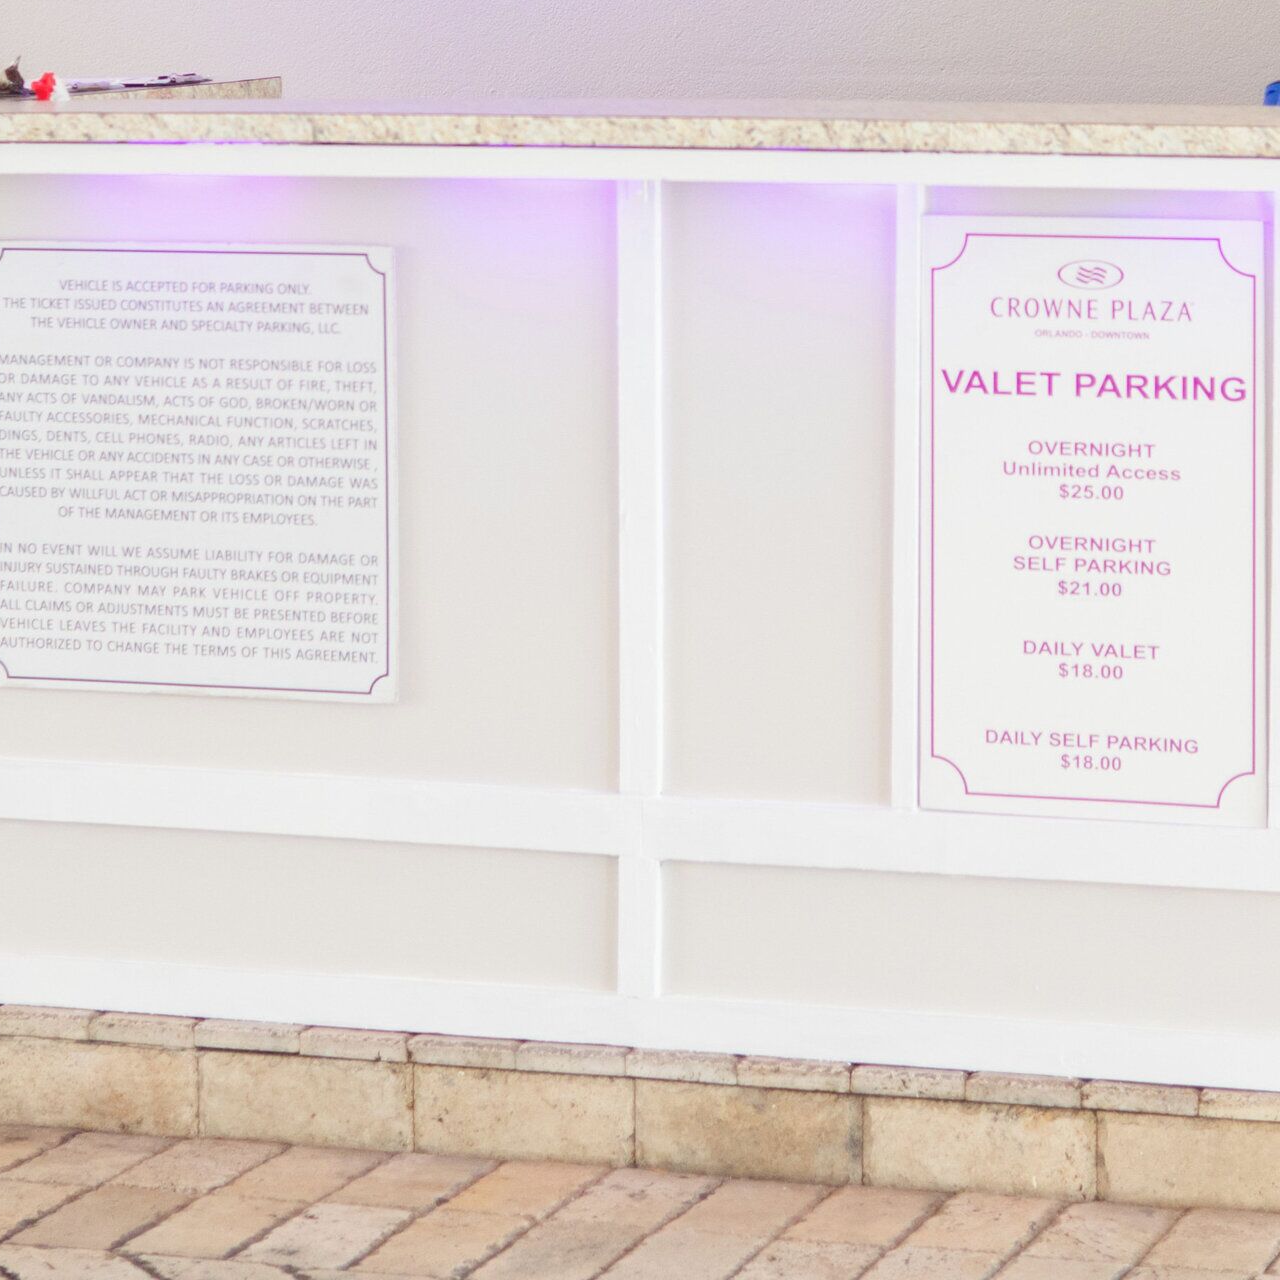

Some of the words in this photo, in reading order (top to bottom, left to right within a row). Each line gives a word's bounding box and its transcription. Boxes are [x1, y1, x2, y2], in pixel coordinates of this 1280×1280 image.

[58, 278, 108, 291] VEHICLE
[111, 279, 123, 292] IS
[124, 279, 188, 293] ACCEPTED
[191, 280, 216, 293] FOR
[218, 281, 274, 294] PARKING
[1, 295, 27, 309] THE
[29, 296, 71, 310] TICKET
[72, 297, 117, 311] ISSUED
[118, 298, 203, 313] CONSTITUTES
[205, 299, 224, 313] AN
[227, 300, 305, 315] AGREEMENT
[307, 301, 369, 316] BETWEEN
[990, 297, 1099, 320] CROWNE
[1111, 299, 1192, 322] PLAZA
[30, 315, 53, 329] THE
[56, 316, 105, 330] VEHICLE
[109, 317, 157, 331] OWNER
[159, 318, 188, 332] AND
[191, 318, 253, 333] SPECIALTY
[1034, 329, 1083, 338] ORLANDO
[1091, 330, 1150, 340] DOWNTOWN
[93, 354, 113, 368] OR
[114, 354, 180, 369] COMPANY
[182, 356, 195, 369] IS
[197, 356, 226, 370] NOT
[228, 357, 314, 372] RESPONSIBLE
[316, 359, 344, 373] FOR
[345, 360, 377, 374] LOSS
[941, 369, 1061, 397] VALET
[1075, 373, 1246, 402] PARKING
[25, 391, 58, 404] ACTS
[60, 391, 76, 405] OF
[162, 394, 195, 408] ACTS
[197, 395, 215, 408] OF
[358, 399, 376, 413] OR
[137, 412, 222, 428] MECHANICAL
[94, 430, 124, 444] CELL
[237, 434, 265, 448] ANY
[266, 435, 326, 450] ARTICLES
[329, 437, 359, 451] LEFT
[363, 438, 377, 451] IN
[1028, 440, 1155, 458] OVERNIGHT
[1003, 460, 1099, 478] Unlimited
[1106, 464, 1181, 481] Access
[49, 486, 66, 499] BY
[67, 486, 120, 501] WILLFUL
[122, 488, 147, 502] ACT
[149, 489, 168, 502] OR
[168, 489, 295, 506] MISAPPROPRIATION
[295, 493, 317, 507] ON
[319, 494, 344, 508] THE
[346, 495, 378, 509] PART
[1059, 483, 1124, 500] $25.00
[56, 505, 75, 518] OF
[77, 505, 101, 519] THE
[103, 506, 197, 523] MANAGEMENT
[198, 509, 220, 523] OR
[220, 510, 239, 524] ITS
[1028, 535, 1156, 554] OVERNIGHT
[44, 561, 114, 576] SUSTAINED
[115, 564, 178, 579] THROUGH
[181, 566, 229, 581] FAULTY
[229, 568, 278, 582] BRAKES
[278, 569, 299, 583] OR
[301, 570, 378, 586] EQUIPMENT
[1013, 555, 1066, 572] SELF
[1074, 558, 1171, 576] PARKING
[63, 581, 131, 596] COMPANY
[137, 583, 166, 597] MAY
[172, 585, 206, 599] PARK
[212, 586, 267, 601] VEHICLE
[273, 588, 299, 602] OFF
[1058, 580, 1122, 597] $21.00
[23, 598, 72, 613] CLAIMS
[74, 600, 94, 614] OR
[95, 601, 189, 618] ADJUSTMENTS
[191, 604, 230, 619] MUST
[231, 606, 249, 620] BE
[252, 607, 326, 623] PRESENTED
[329, 609, 378, 625] BEFORE
[0, 616, 53, 631] VEHICLE
[59, 618, 106, 633] LEAVES
[111, 620, 135, 634] THE
[141, 621, 197, 637] FACILITY
[201, 624, 230, 638] AND
[236, 625, 314, 642] EMPLOYEES
[319, 628, 344, 643] ARE
[351, 630, 378, 644] NOT
[0, 635, 82, 652] AUTHORIZED
[85, 638, 104, 652] TO
[105, 639, 160, 655] CHANGE
[163, 641, 188, 656] THE
[191, 642, 237, 658] TERMS
[239, 644, 258, 659] OF
[261, 645, 292, 660] THIS
[1023, 640, 1083, 656] DAILY
[1091, 643, 1159, 660] VALET
[1058, 662, 1123, 680] $18.00
[985, 729, 1042, 746] DAILY
[1049, 732, 1099, 748] SELF
[1107, 735, 1199, 754] PARKING
[1061, 753, 1122, 771] $18.00
